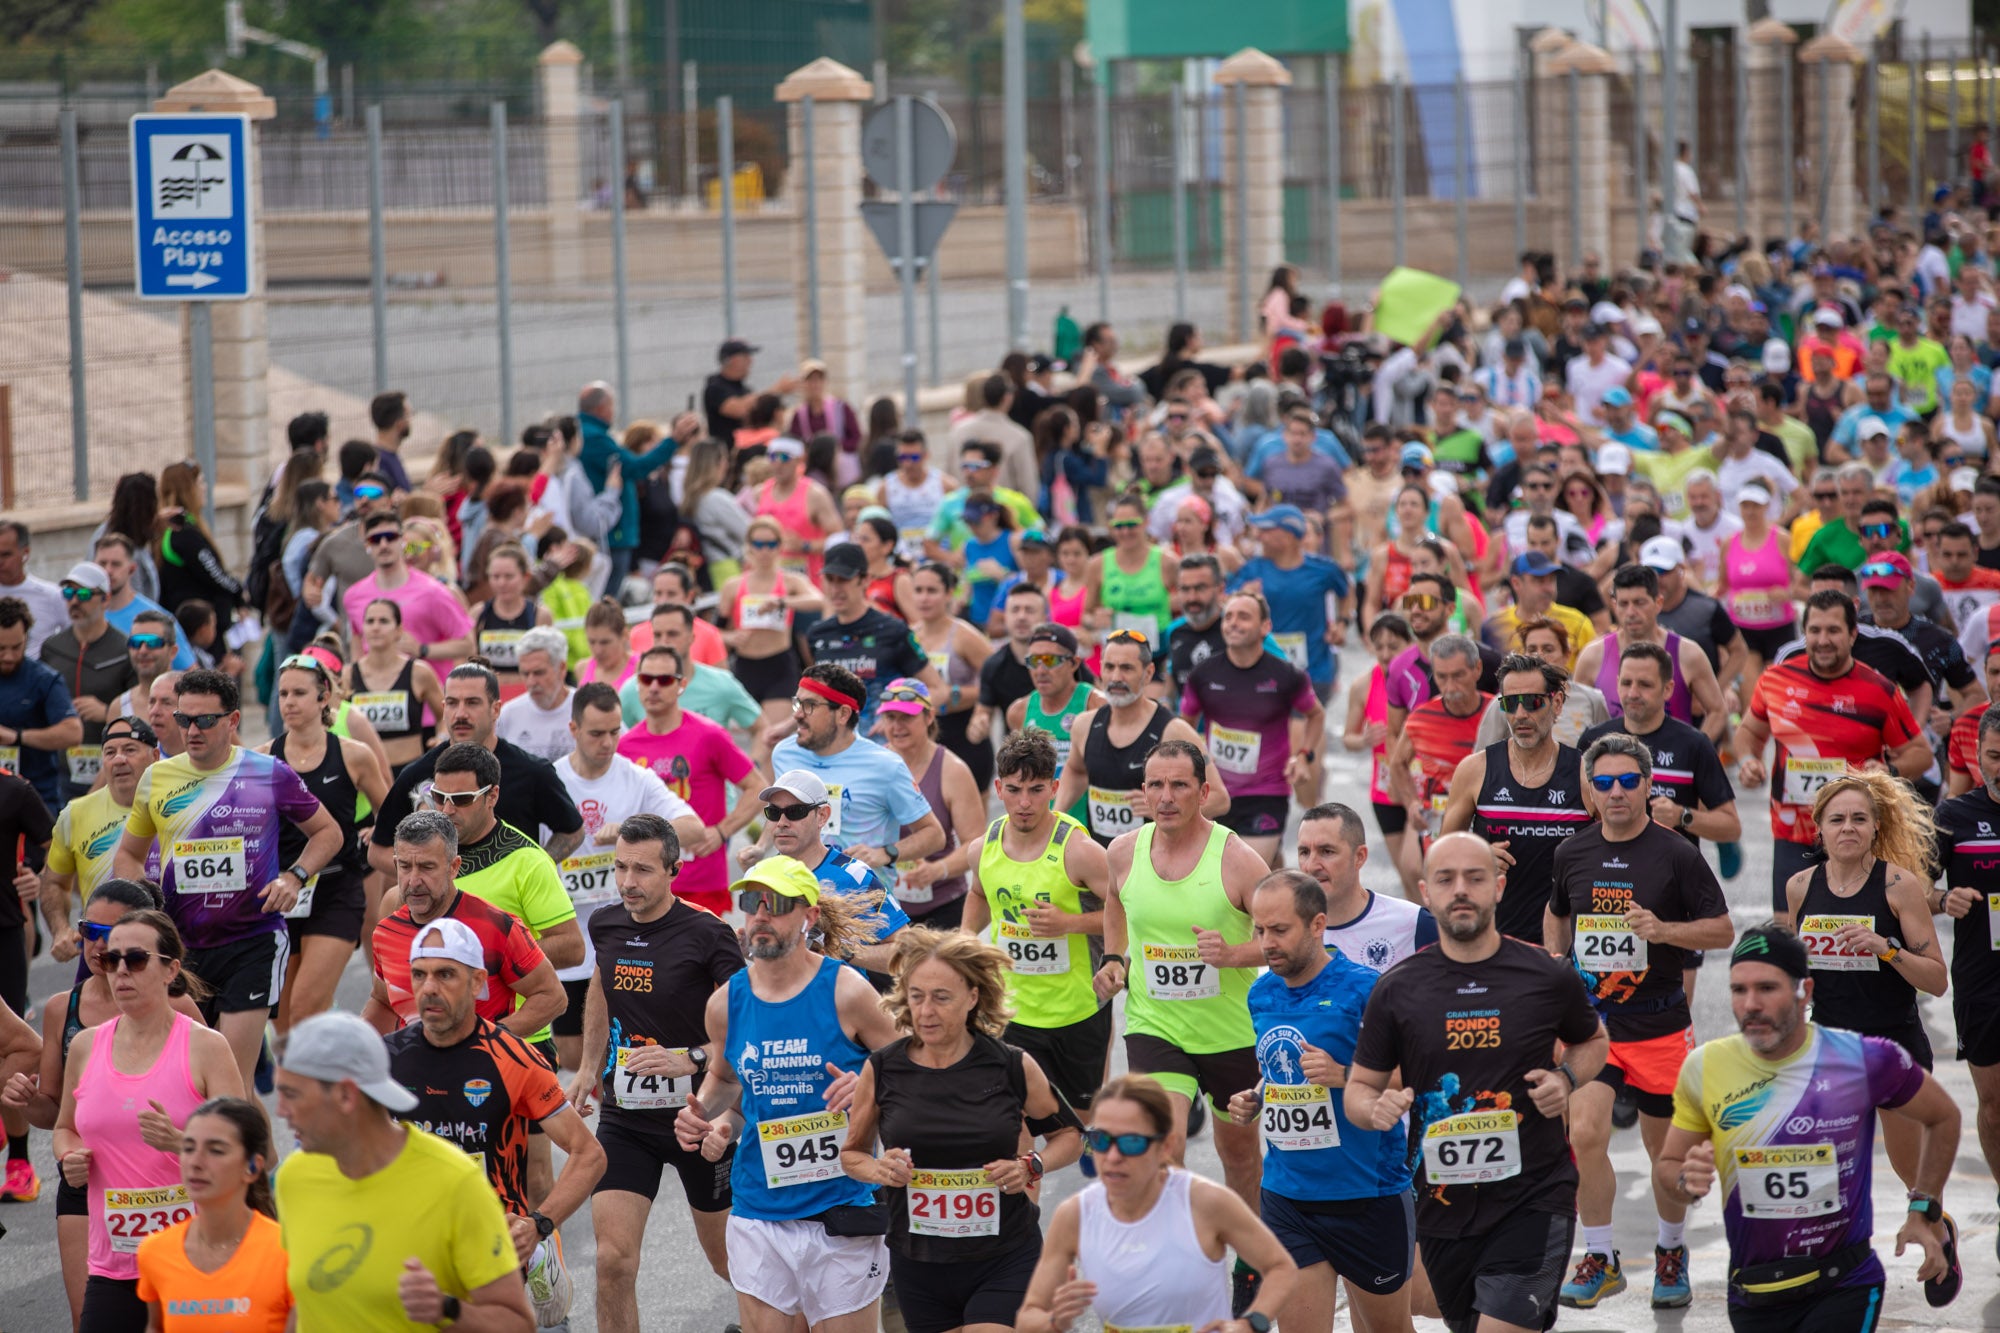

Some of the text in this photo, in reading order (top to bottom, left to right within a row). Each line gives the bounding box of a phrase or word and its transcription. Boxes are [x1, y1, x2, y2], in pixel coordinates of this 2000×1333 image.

[152, 226, 232, 246] Acceso
[163, 247, 223, 270] Playa
[1095, 805, 1133, 825] 940
[184, 856, 234, 879] 664
[1592, 888, 1633, 899] FONDO
[1611, 881, 1634, 889] PREMIO
[1592, 898, 1631, 913] 2025
[1008, 942, 1058, 961] 864
[1584, 935, 1635, 956] 264
[615, 965, 653, 978] FONDO
[1155, 965, 1206, 986] 987
[613, 975, 653, 993] 2025
[1446, 1009, 1501, 1019] GRAN PREMIO
[1446, 1017, 1501, 1032] FONDO
[762, 1039, 808, 1056] TEAM
[1258, 1032, 1277, 1058] SIERRA
[1278, 1030, 1293, 1038] SUR
[1447, 1029, 1502, 1051] 2025
[762, 1055, 822, 1069] RUNNING
[624, 1070, 675, 1093] 741
[752, 1078, 814, 1096] Encarnita
[435, 1121, 453, 1137] del
[1265, 1106, 1332, 1133] 3094
[1815, 1114, 1859, 1129] Arrebola
[770, 1123, 785, 1136] 38
[776, 1135, 839, 1168] 945
[1438, 1137, 1506, 1166] 672
[920, 1173, 933, 1184] 38
[1765, 1171, 1809, 1199] 65
[911, 1192, 995, 1219] 2196
